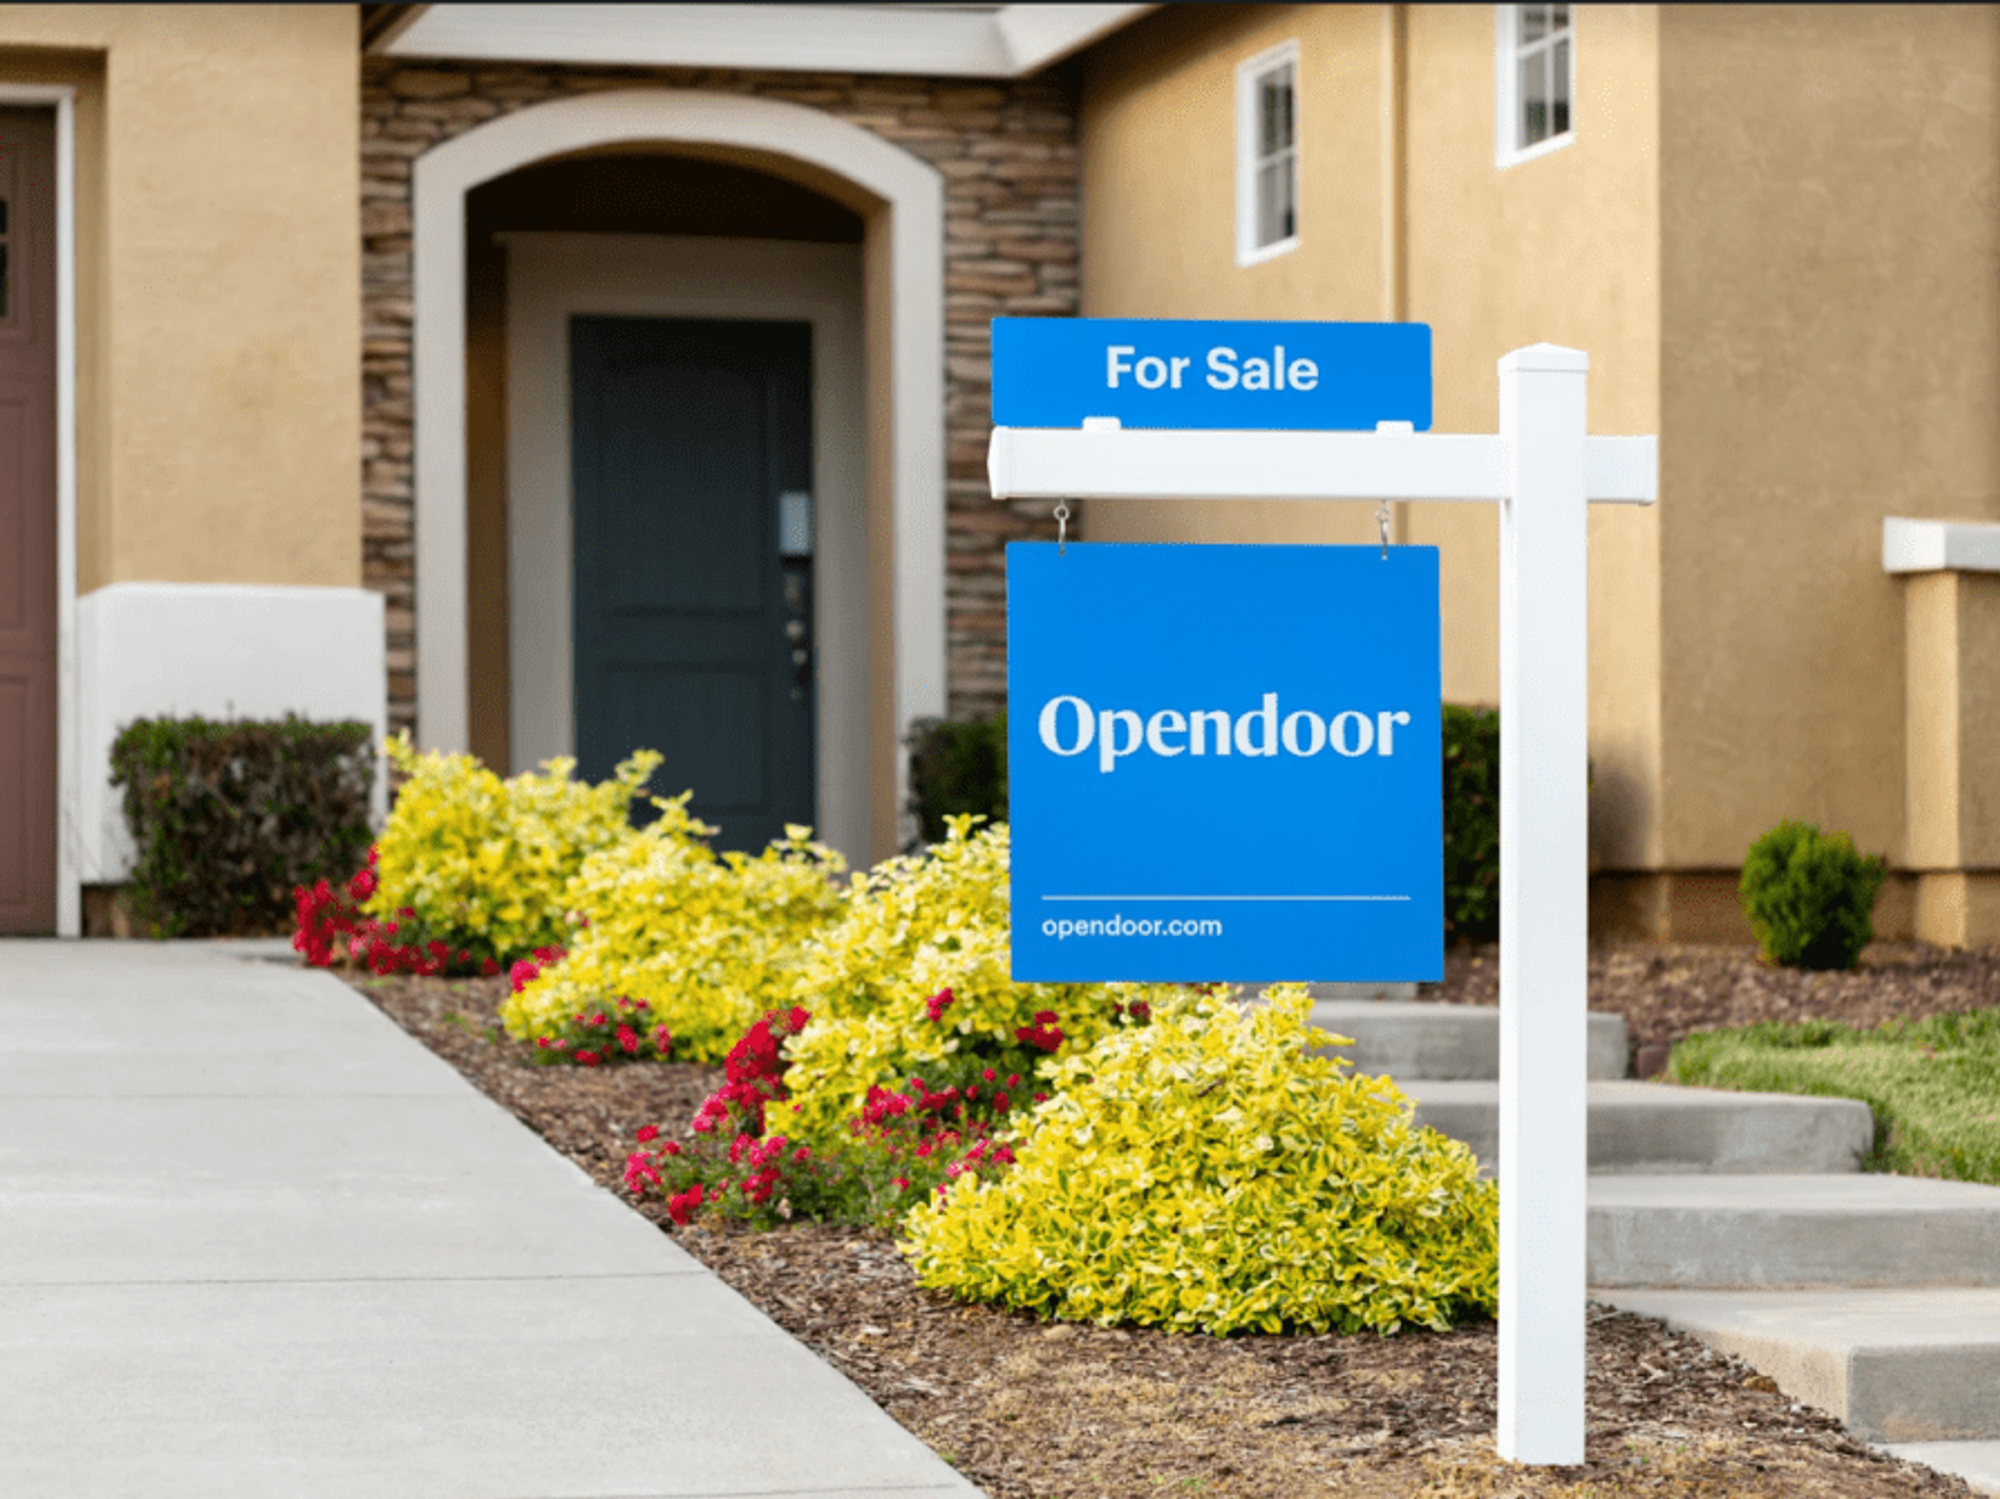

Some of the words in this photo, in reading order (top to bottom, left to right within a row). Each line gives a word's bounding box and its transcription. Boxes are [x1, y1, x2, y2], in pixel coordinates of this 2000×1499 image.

[1106, 345, 1191, 390] For
[1206, 345, 1319, 391] Sale
[1038, 692, 1411, 774] Opendoor
[1042, 914, 1222, 940] opendoor.com
